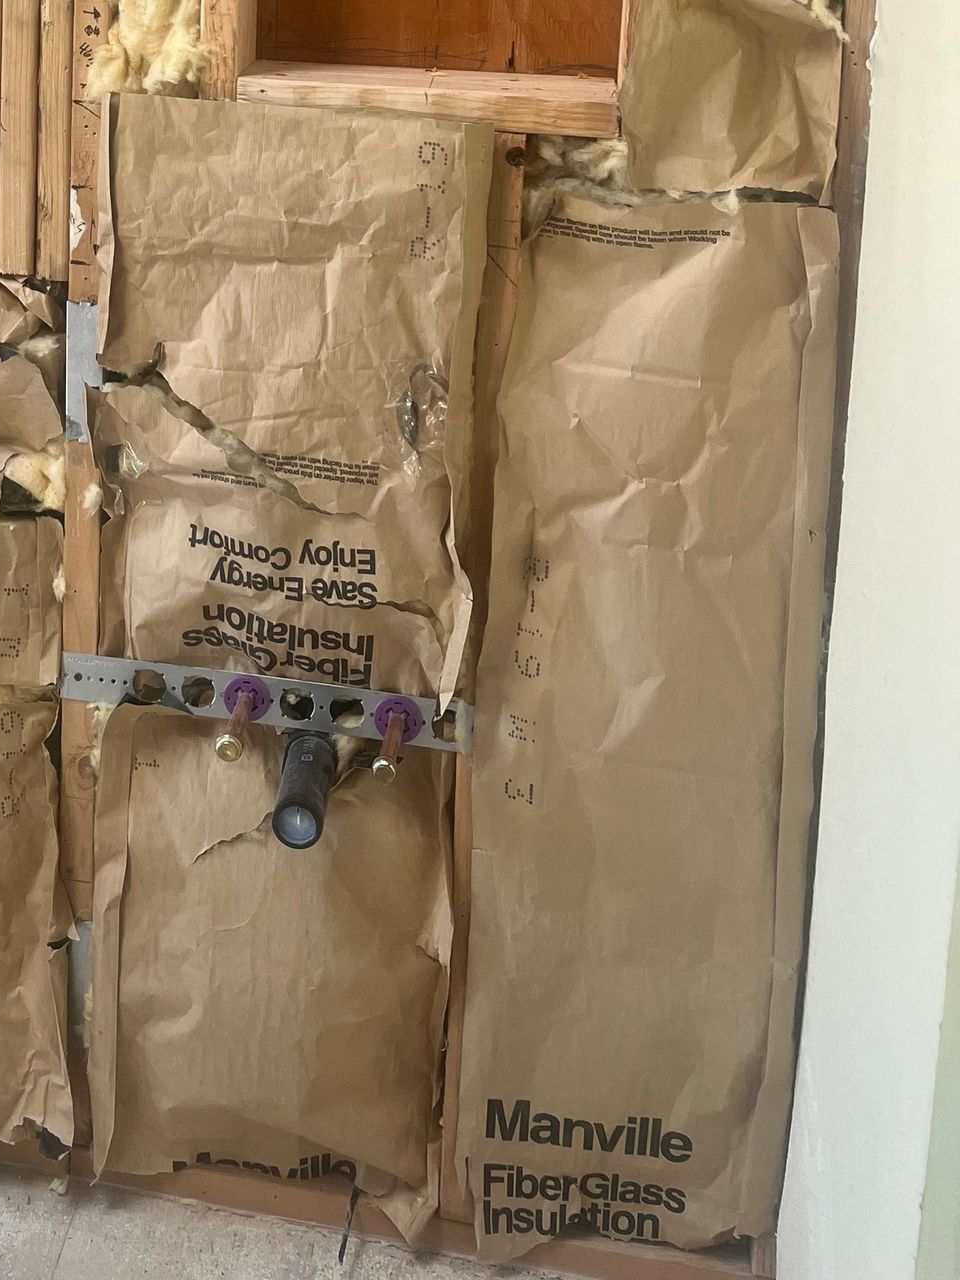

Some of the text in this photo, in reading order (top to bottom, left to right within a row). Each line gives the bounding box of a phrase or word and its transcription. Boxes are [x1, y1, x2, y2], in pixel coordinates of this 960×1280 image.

[189, 523, 376, 575] Enjoy Comfort
[209, 556, 378, 609] Save Energy
[203, 604, 374, 661] Insulation
[485, 1098, 693, 1163] Manville
[483, 1163, 686, 1214] FiberGlass
